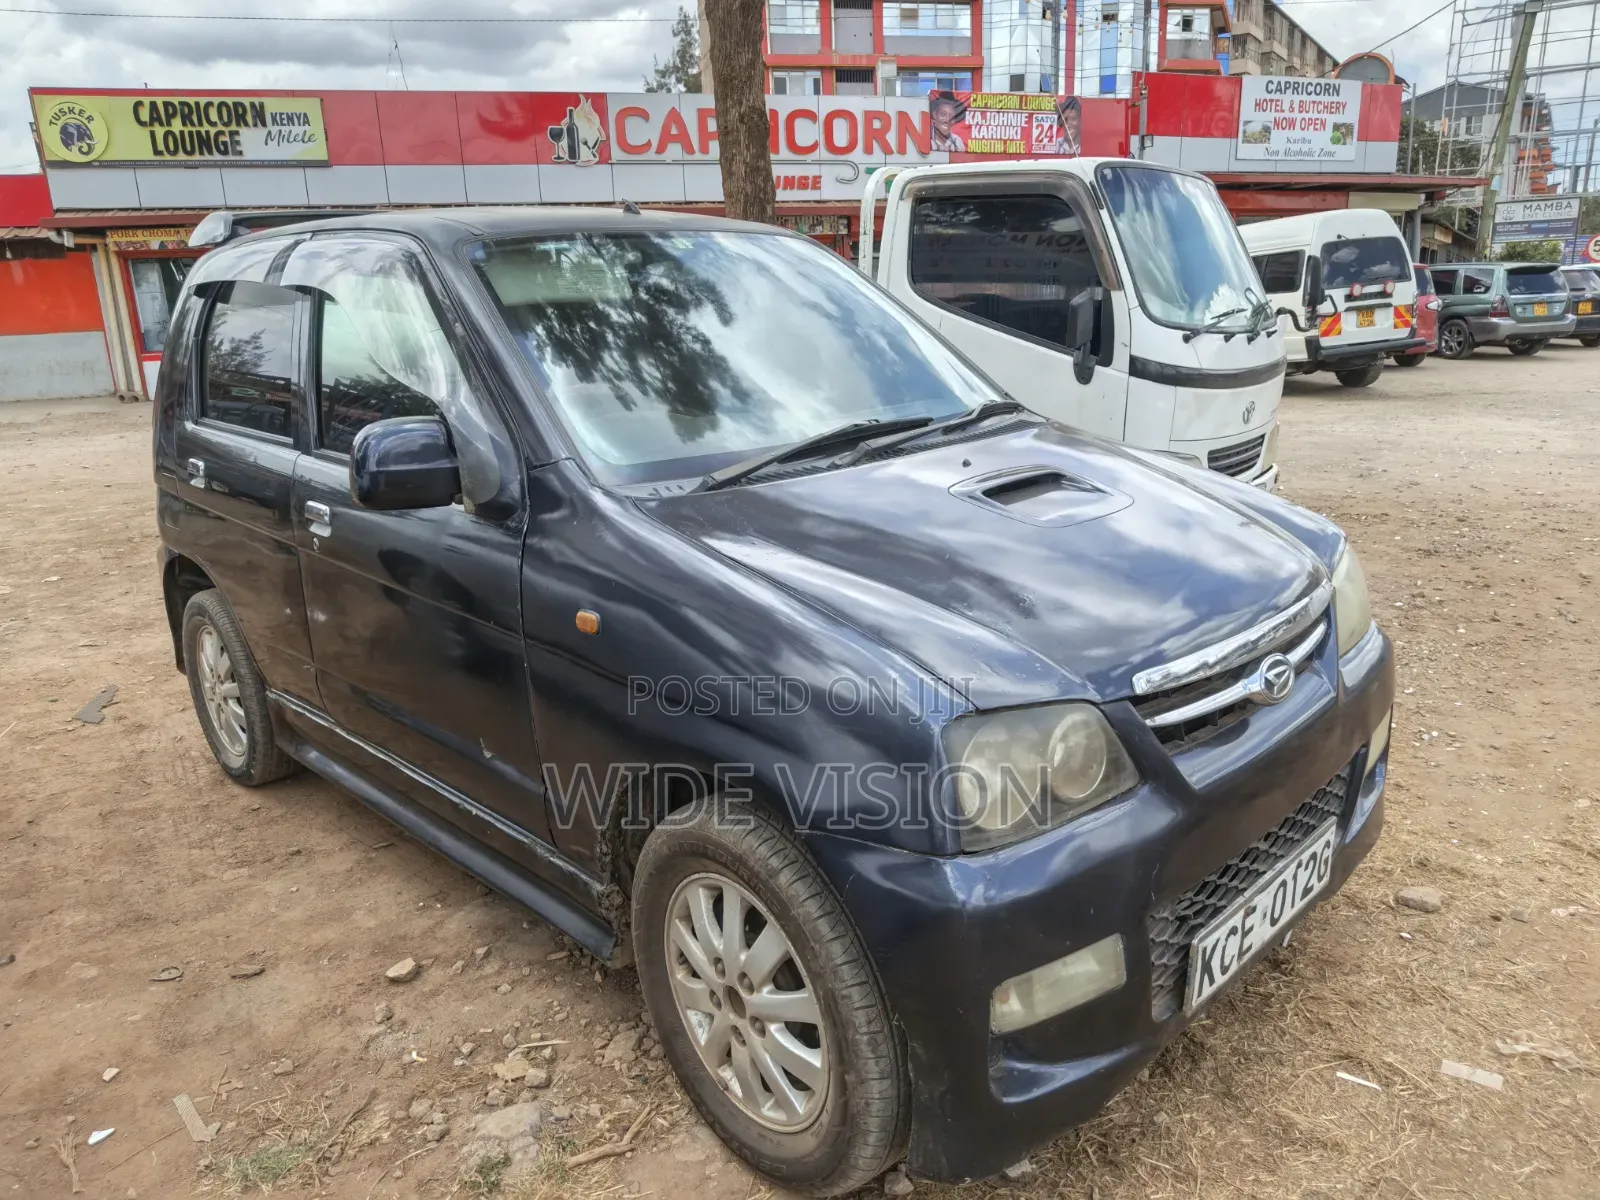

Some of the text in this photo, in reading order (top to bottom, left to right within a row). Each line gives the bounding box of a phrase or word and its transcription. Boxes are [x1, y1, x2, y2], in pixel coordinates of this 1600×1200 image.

[1265, 80, 1341, 97] CAPRICORN
[970, 94, 1056, 110] CAPRICORN LOUNGE
[1254, 98, 1347, 115] HOTEL & BUTCHERY
[49, 106, 95, 127] TUSKER
[132, 100, 267, 128] CAPRICORN
[270, 112, 311, 127] KENYA
[965, 111, 1029, 128] KAJOHNIE
[1034, 115, 1056, 124] SATO
[1272, 116, 1326, 132] NOW OPEN
[264, 130, 319, 147] Milele
[614, 106, 932, 159] CAPICORN
[971, 125, 1022, 140] KARIUKI
[1034, 124, 1055, 145] 24
[1286, 136, 1312, 145] Karibu
[149, 129, 243, 157] LOUNGE
[967, 140, 1026, 154] MUGITHI NITE
[1264, 147, 1337, 158] Non Alcoholic Zone
[775, 175, 822, 191] UNGE
[1522, 210, 1573, 220] ENT CLINIC
[1523, 201, 1573, 213] MAMBA
[109, 229, 139, 239] PORK
[141, 229, 180, 239] CHOMA
